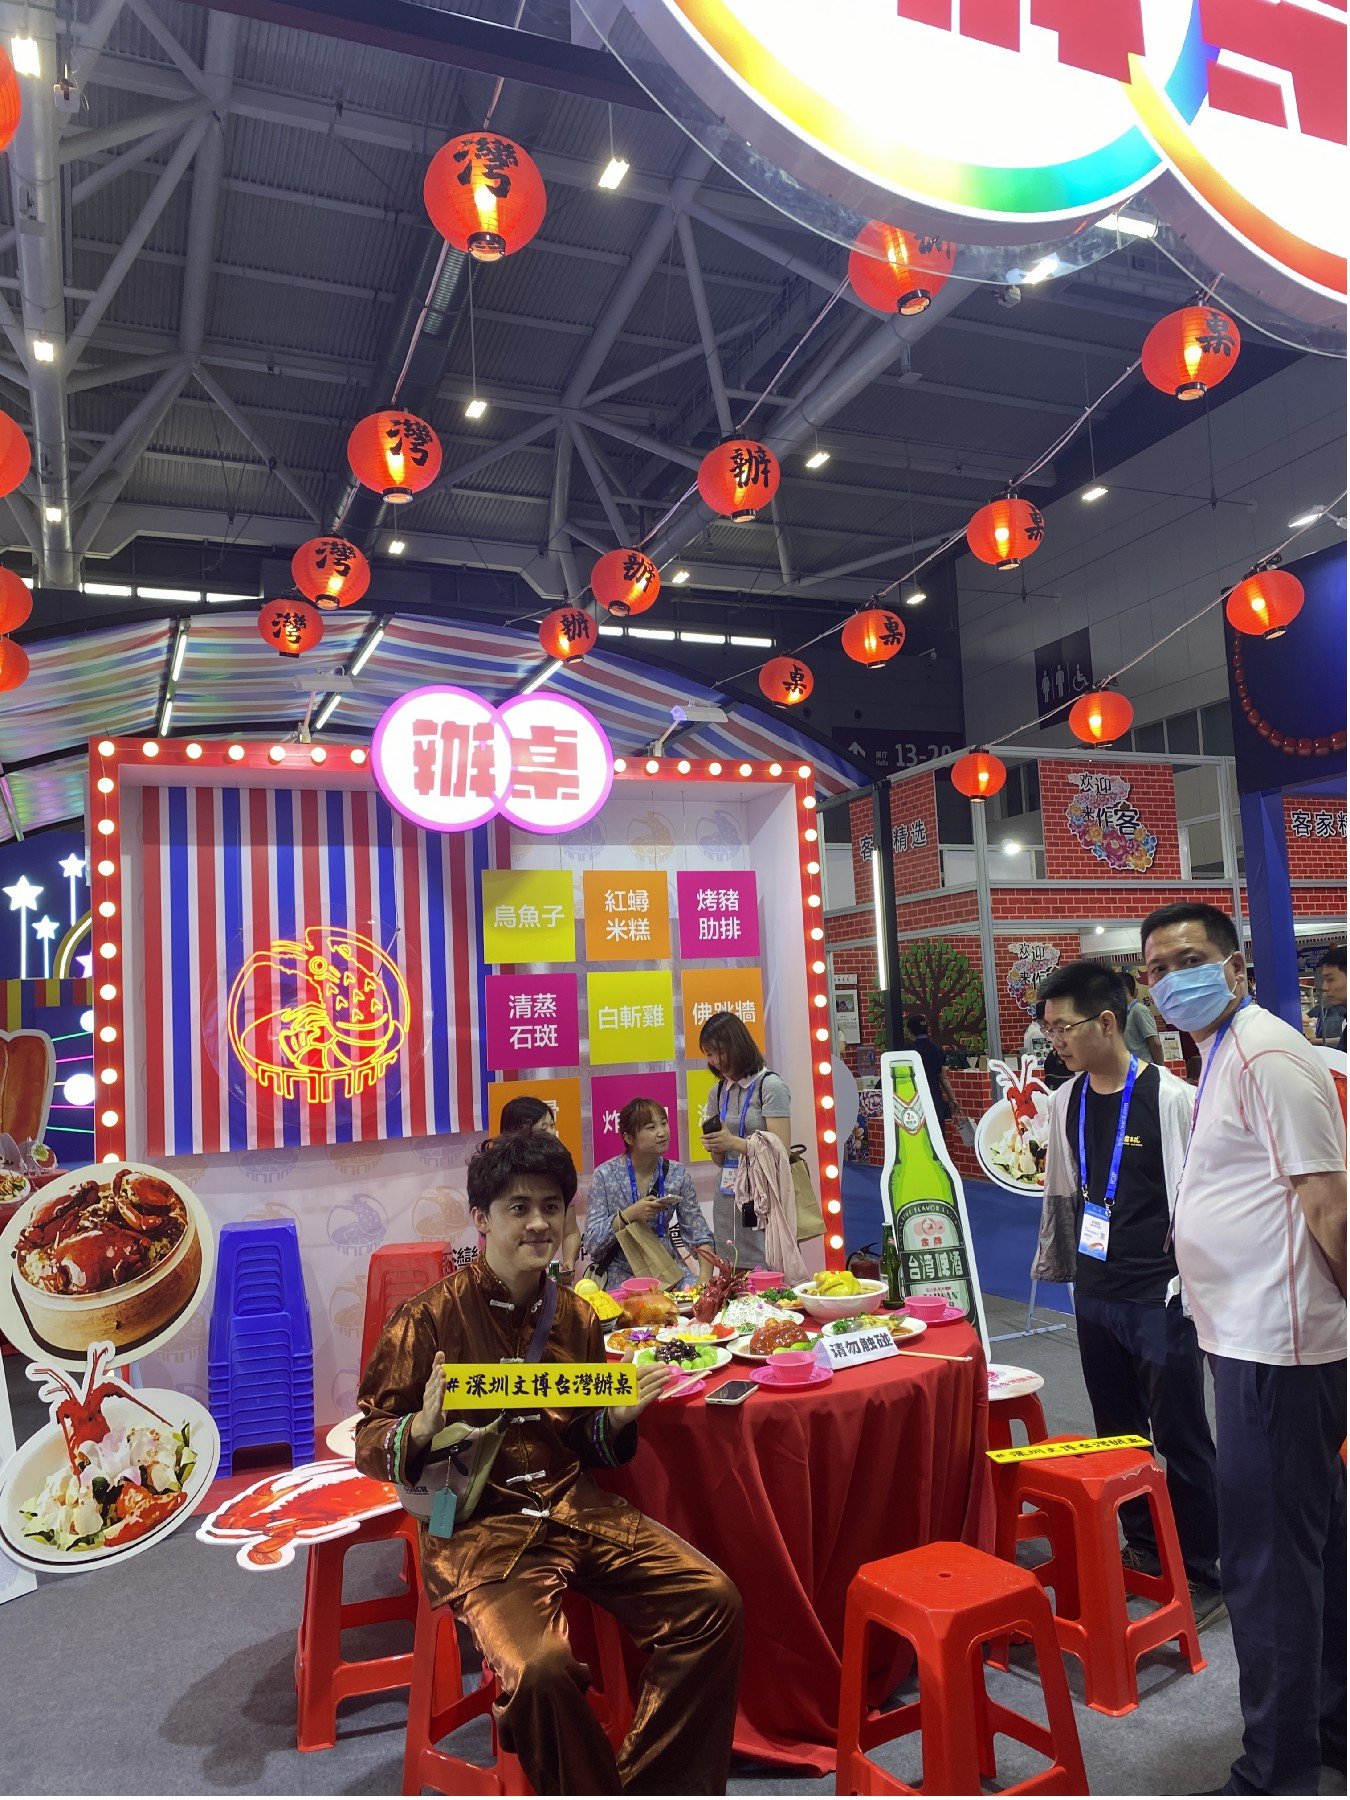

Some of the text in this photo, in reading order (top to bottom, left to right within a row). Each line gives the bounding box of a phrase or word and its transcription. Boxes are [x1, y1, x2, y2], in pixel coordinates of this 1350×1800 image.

[412, 718, 580, 801] 辦桌
[1080, 773, 1112, 795] 欢迎
[860, 819, 927, 861] 客精选
[604, 889, 650, 914] 紅蟳
[697, 888, 740, 914] 烤豬
[493, 904, 565, 930] 烏魚子
[605, 917, 651, 942] 米糕
[698, 917, 742, 942] 肋排
[1019, 943, 1045, 962] 欢迎
[508, 993, 558, 1020] 清蒸
[598, 1004, 665, 1031] 白斬雞
[509, 1025, 559, 1051] 石斑
[829, 1332, 894, 1358] 请勿触碰
